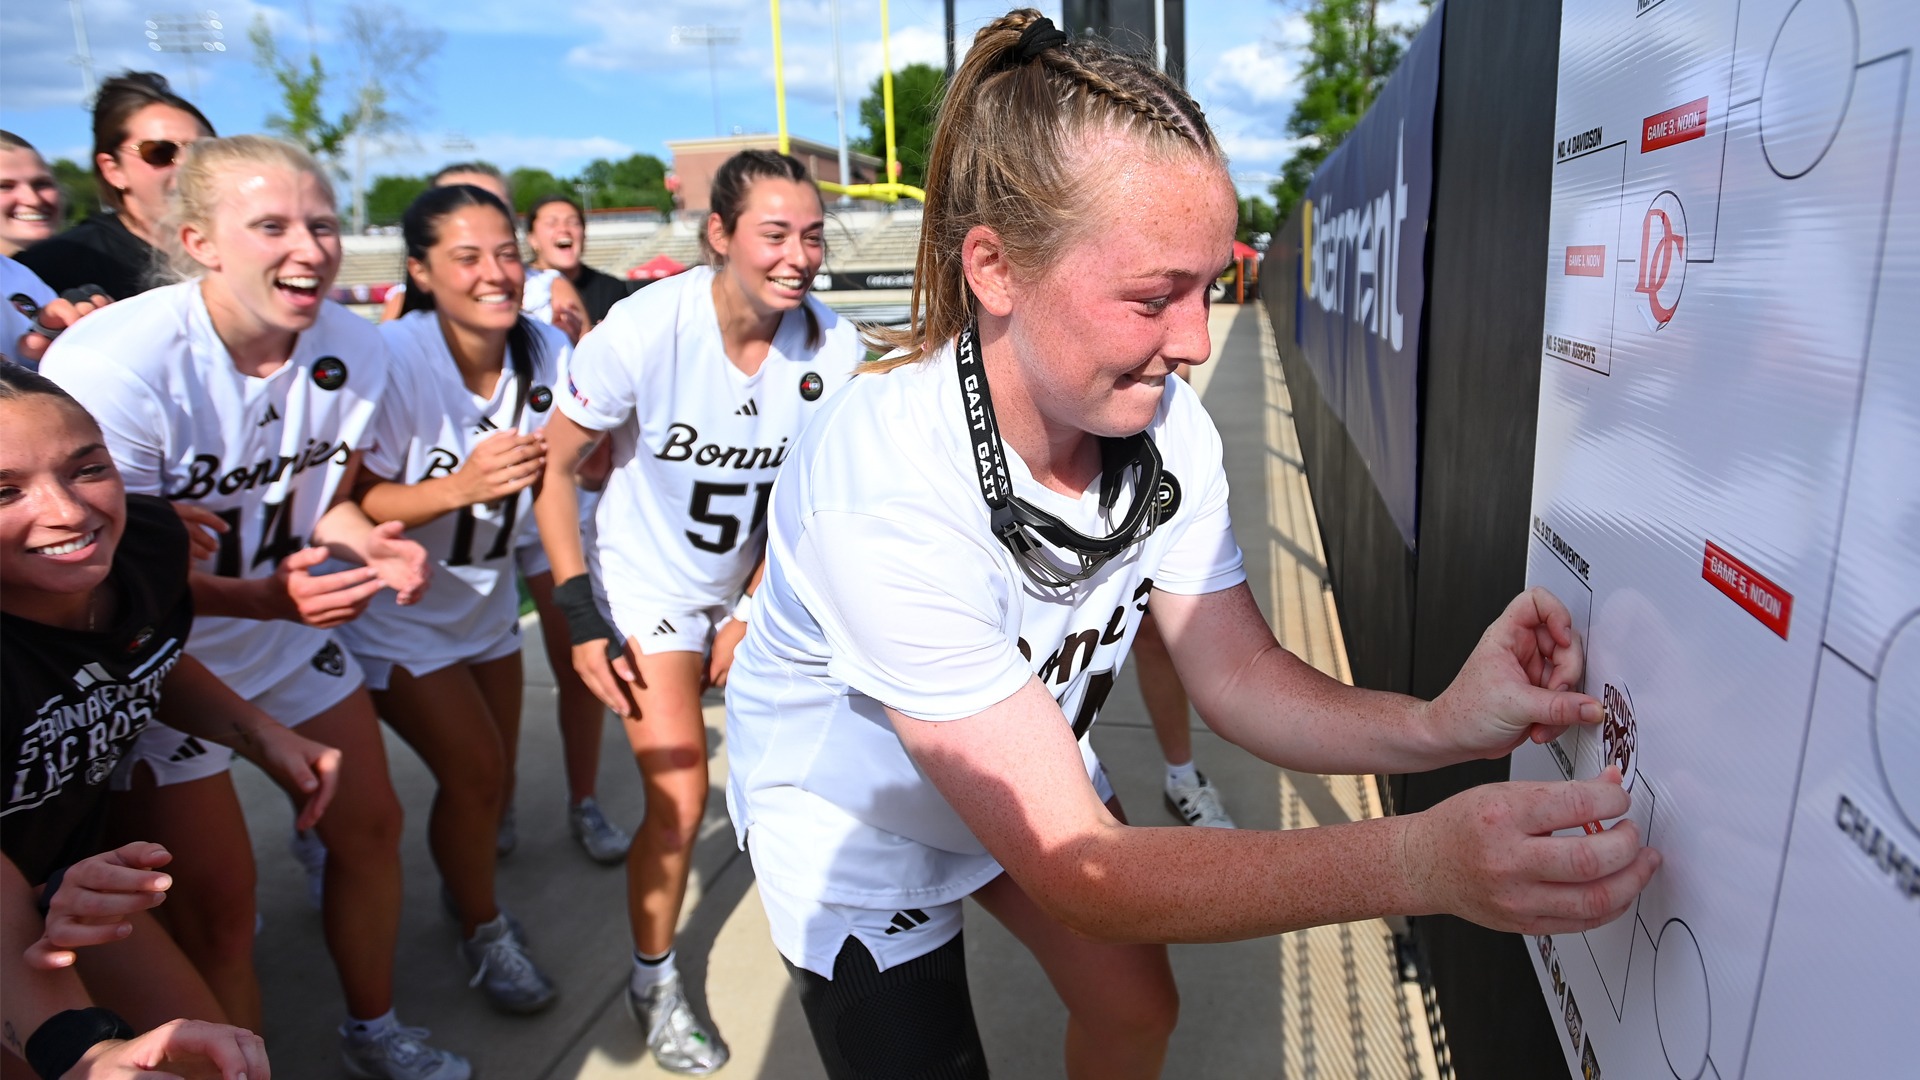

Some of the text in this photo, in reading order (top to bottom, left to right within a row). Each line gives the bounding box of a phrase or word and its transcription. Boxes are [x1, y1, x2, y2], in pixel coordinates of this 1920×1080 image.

[1567, 138, 1571, 155] 4
[1572, 126, 1603, 155] DAVIDSON
[1647, 110, 1701, 141] GAME 3, NOON
[1569, 254, 1582, 267] GAME
[1587, 254, 1601, 267] NOON
[1553, 336, 1557, 352] 5
[1558, 337, 1572, 356] SAINT
[1572, 341, 1596, 364] JOSEPH'S
[964, 374, 986, 431] GAIT
[653, 422, 788, 470] Bonni
[977, 441, 998, 501] GAIT
[214, 489, 304, 578] 14
[1552, 531, 1590, 581] BONAVENTURE
[1711, 555, 1782, 620] GAME 5, NOON
[1603, 683, 1636, 752] BONNIES
